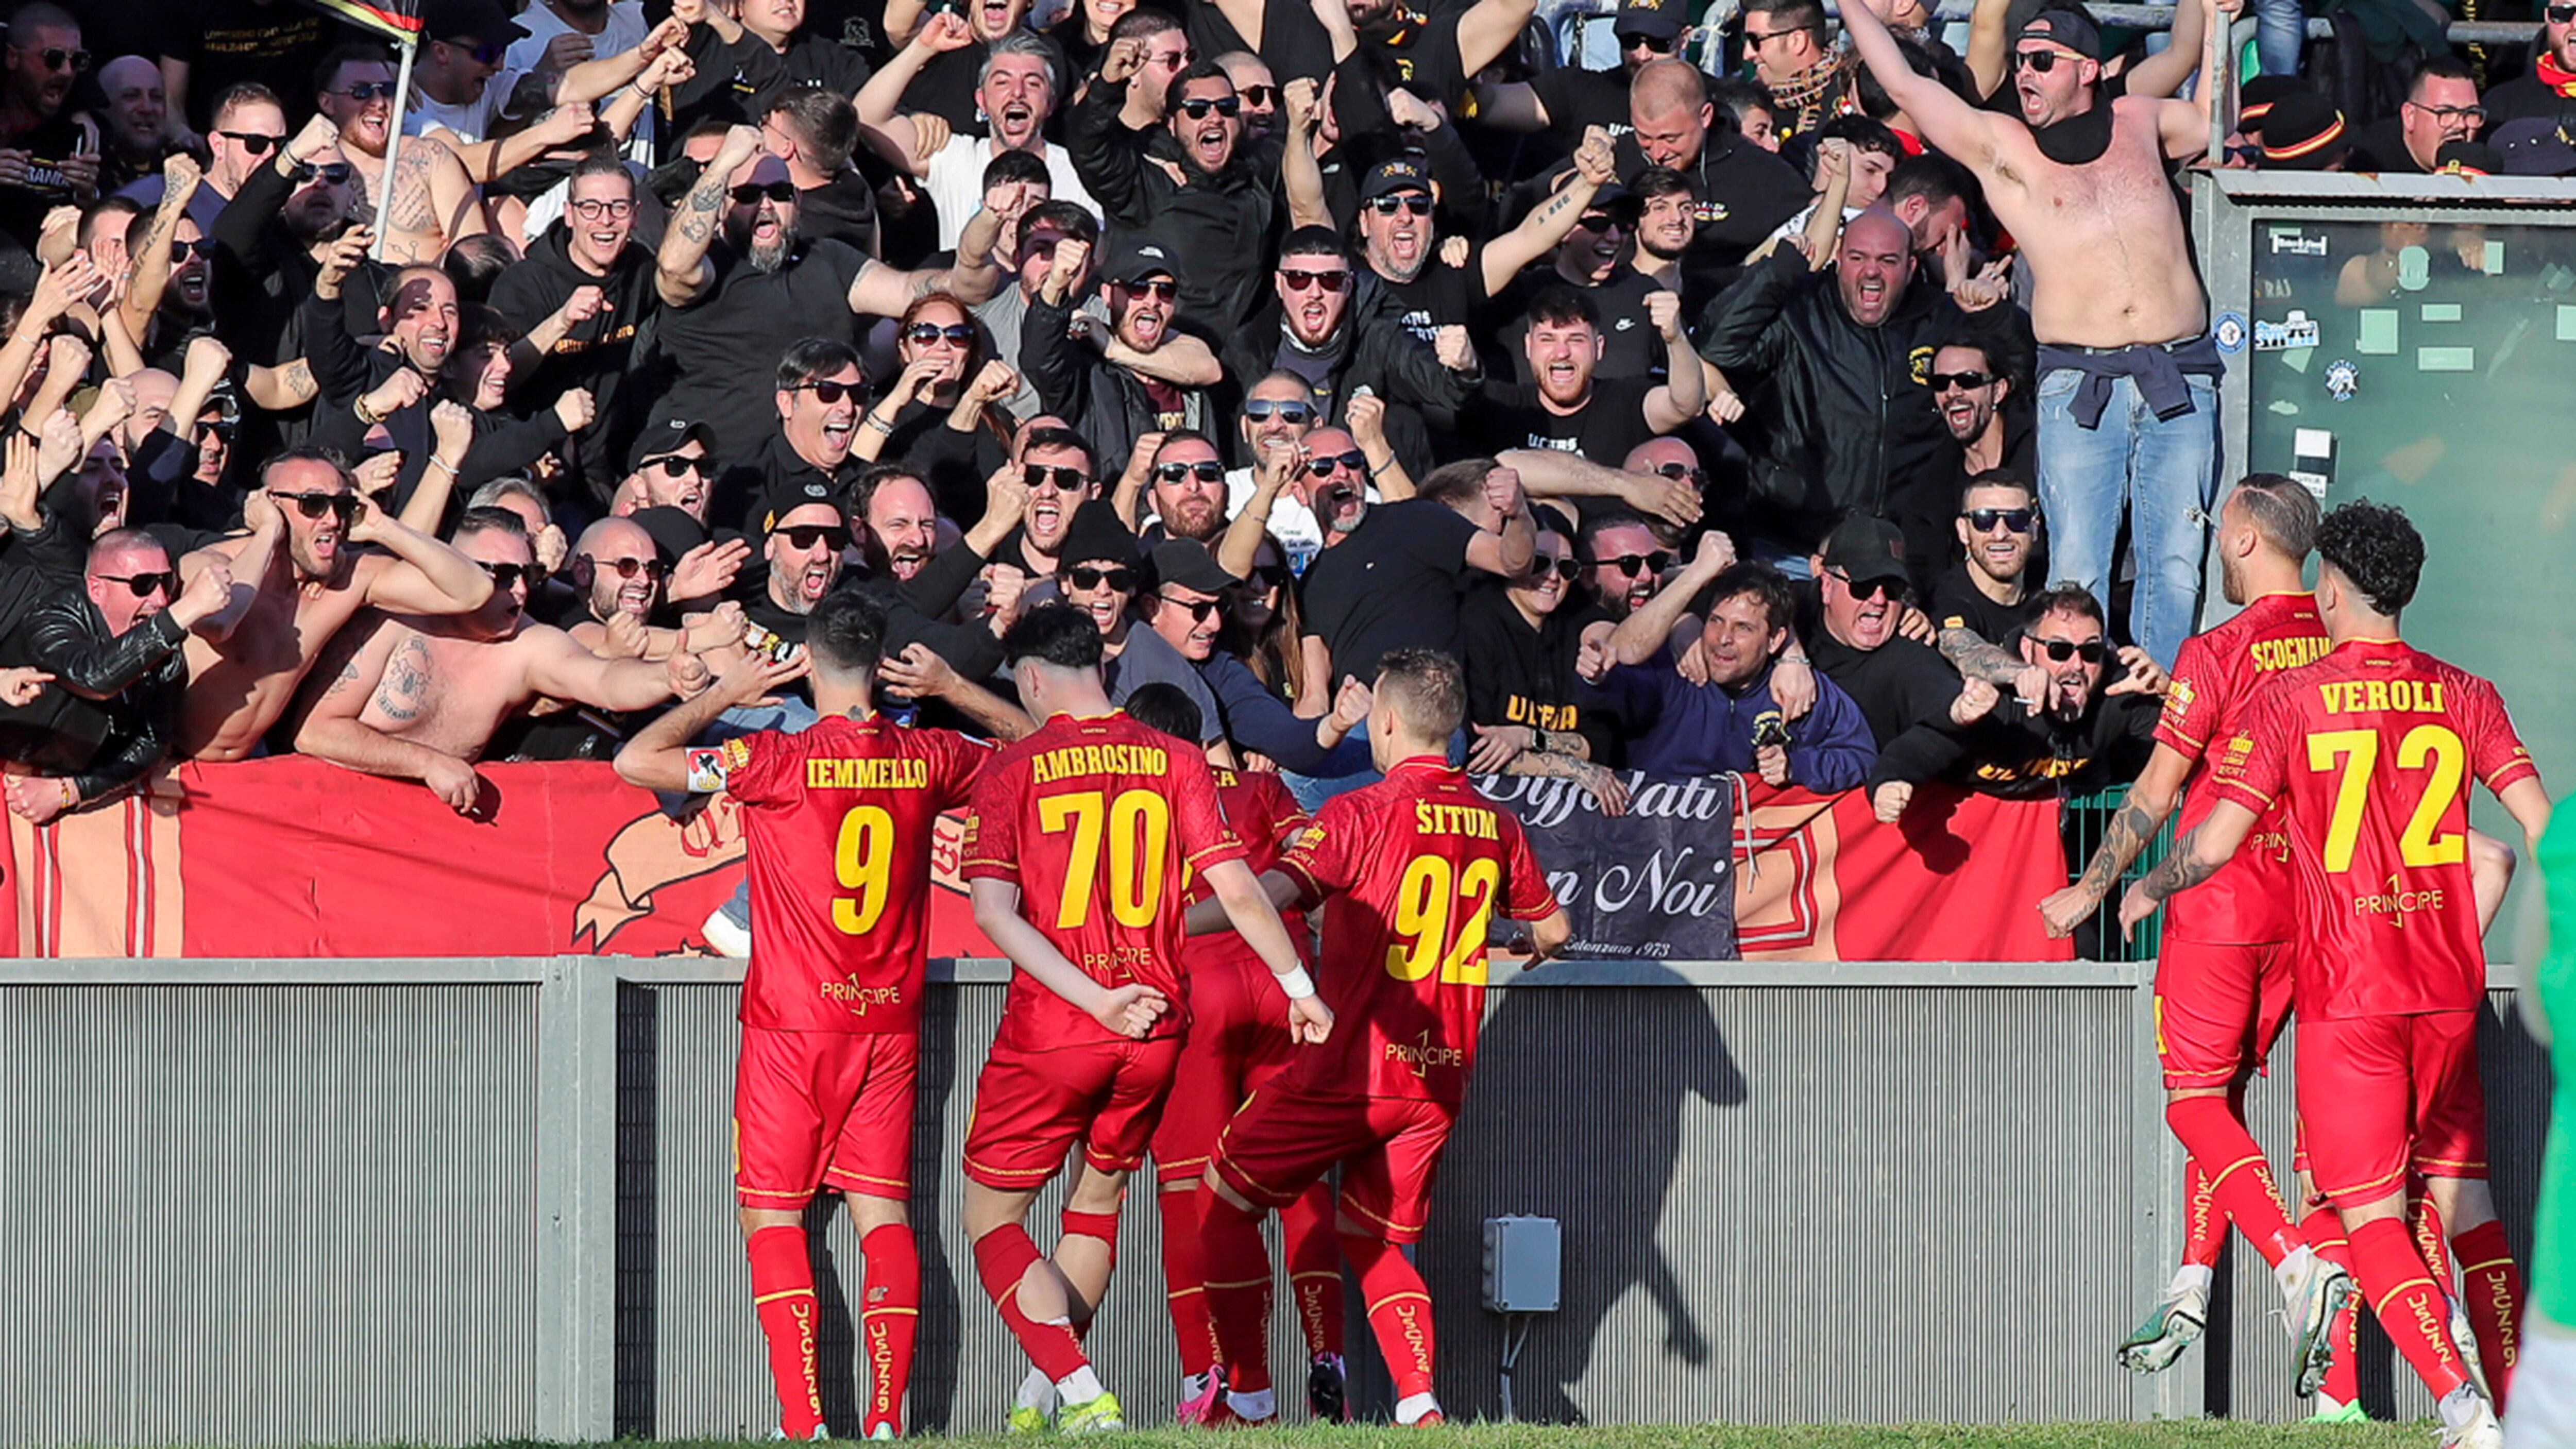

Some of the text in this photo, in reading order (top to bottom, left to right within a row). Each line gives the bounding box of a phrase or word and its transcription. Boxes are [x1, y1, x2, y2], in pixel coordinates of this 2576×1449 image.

[2251, 637, 2335, 672] SCOGNAM
[2319, 680, 2446, 714] VEROLI
[807, 759, 927, 788] IEMMELLO
[1032, 744, 1167, 784] AMBROSINO
[1416, 798, 1499, 840] ŠITUM
[2307, 724, 2465, 872] 72
[832, 805, 894, 935] 9
[1038, 789, 1168, 929] 70
[1595, 847, 1725, 917] Noi
[1385, 854, 1501, 986] 92
[2354, 889, 2444, 916] PRINCIPE
[820, 982, 901, 1004] PRINCIPE
[1385, 1043, 1462, 1067] PRINCIPE
[2486, 1270, 2516, 1369] USCZ29
[790, 1303, 821, 1417] USCZ29
[869, 1321, 892, 1414] USCZ29
